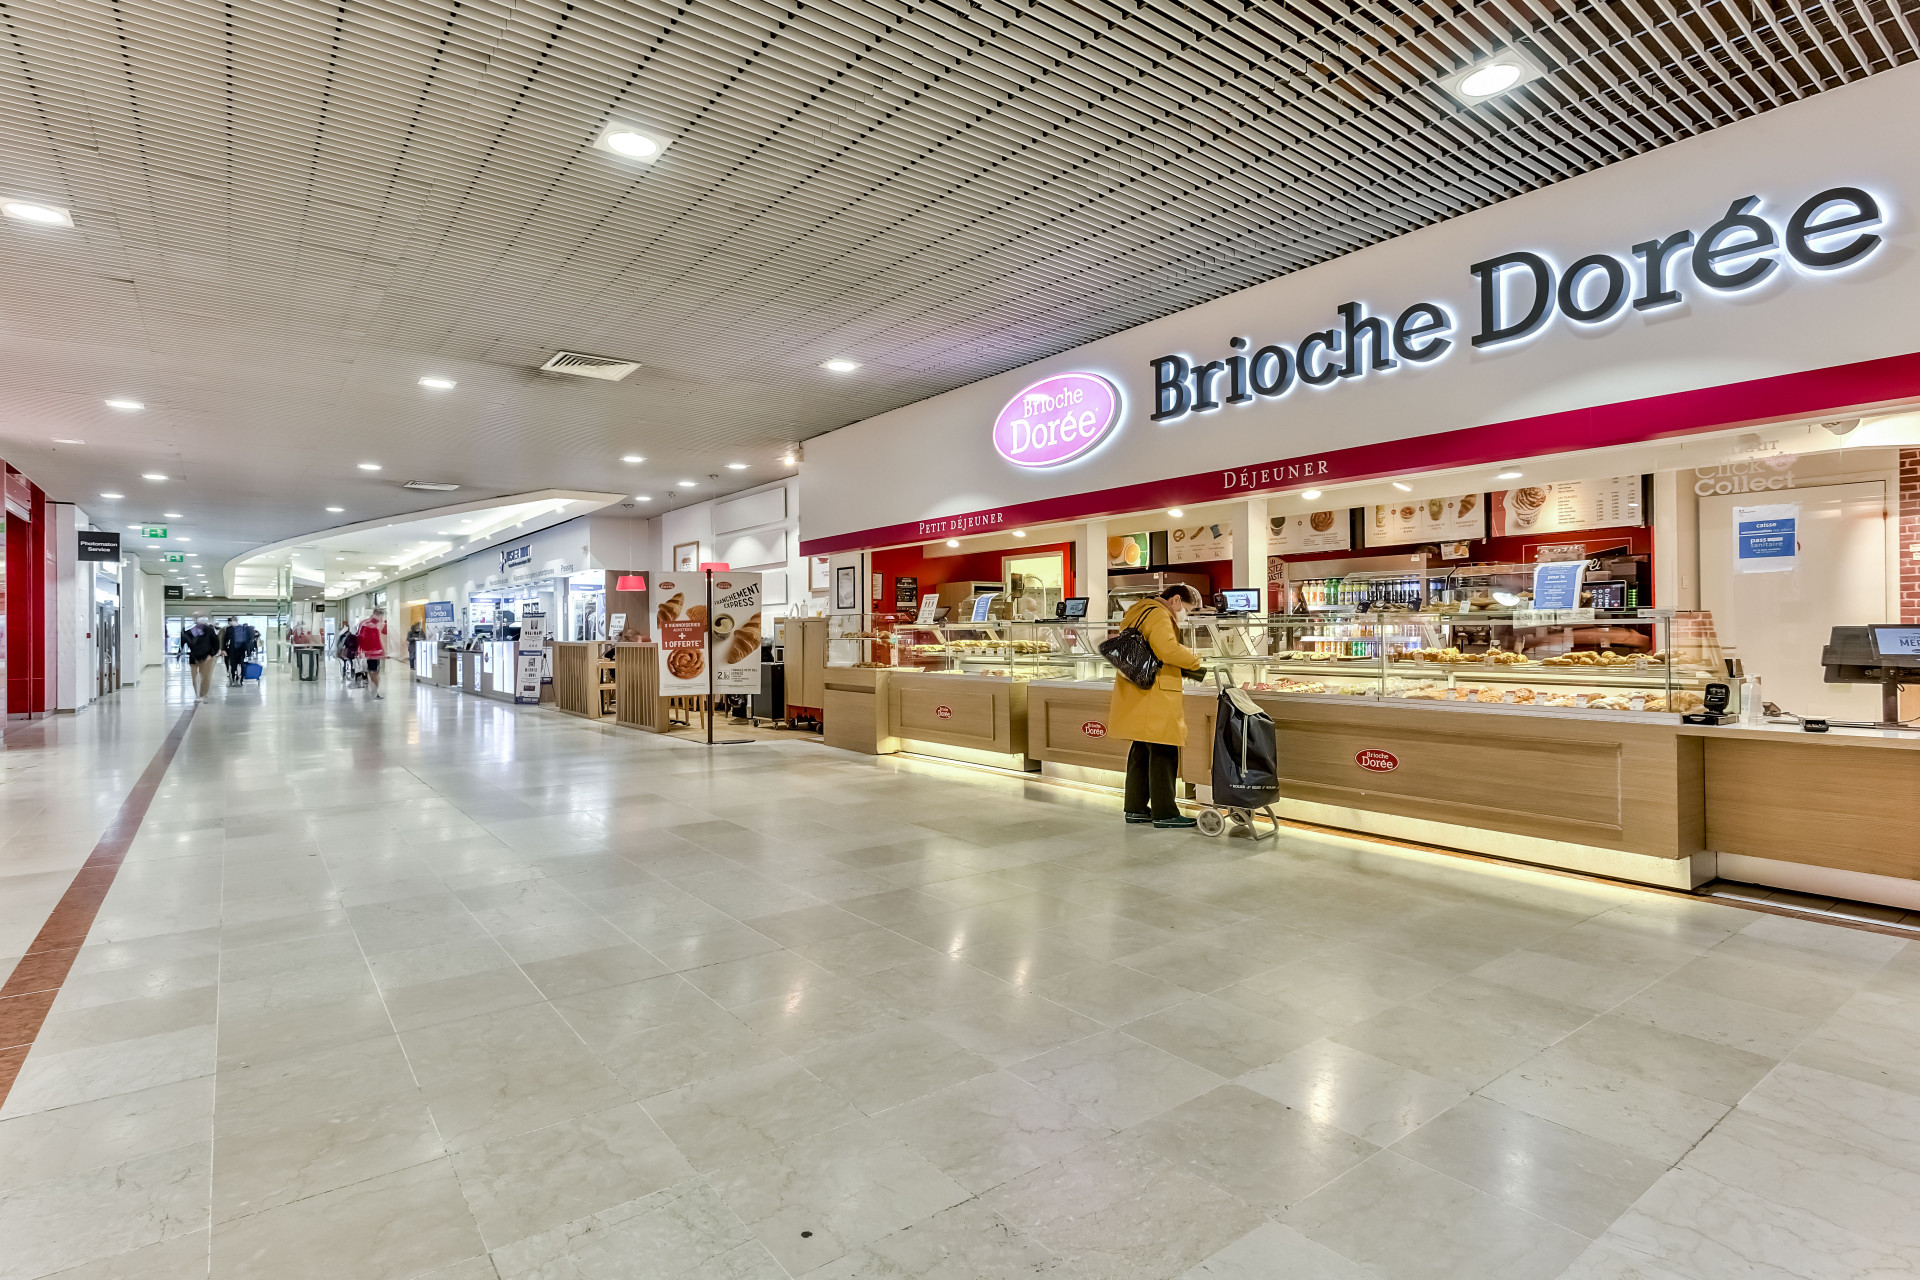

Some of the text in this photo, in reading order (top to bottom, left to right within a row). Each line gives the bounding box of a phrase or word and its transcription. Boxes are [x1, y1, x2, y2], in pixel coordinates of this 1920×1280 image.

[1150, 186, 1883, 422] Brioche Dorée
[1023, 387, 1084, 418] Brioche
[1010, 410, 1098, 455] Dorée
[1695, 456, 1766, 479] Click
[1694, 471, 1796, 497] Collect
[1750, 537, 1767, 545] pass
[1750, 541, 1784, 549] sanitaire
[724, 596, 754, 609] EXPRESS
[1361, 755, 1394, 769] Dorée
[1366, 751, 1389, 760] Brioche
